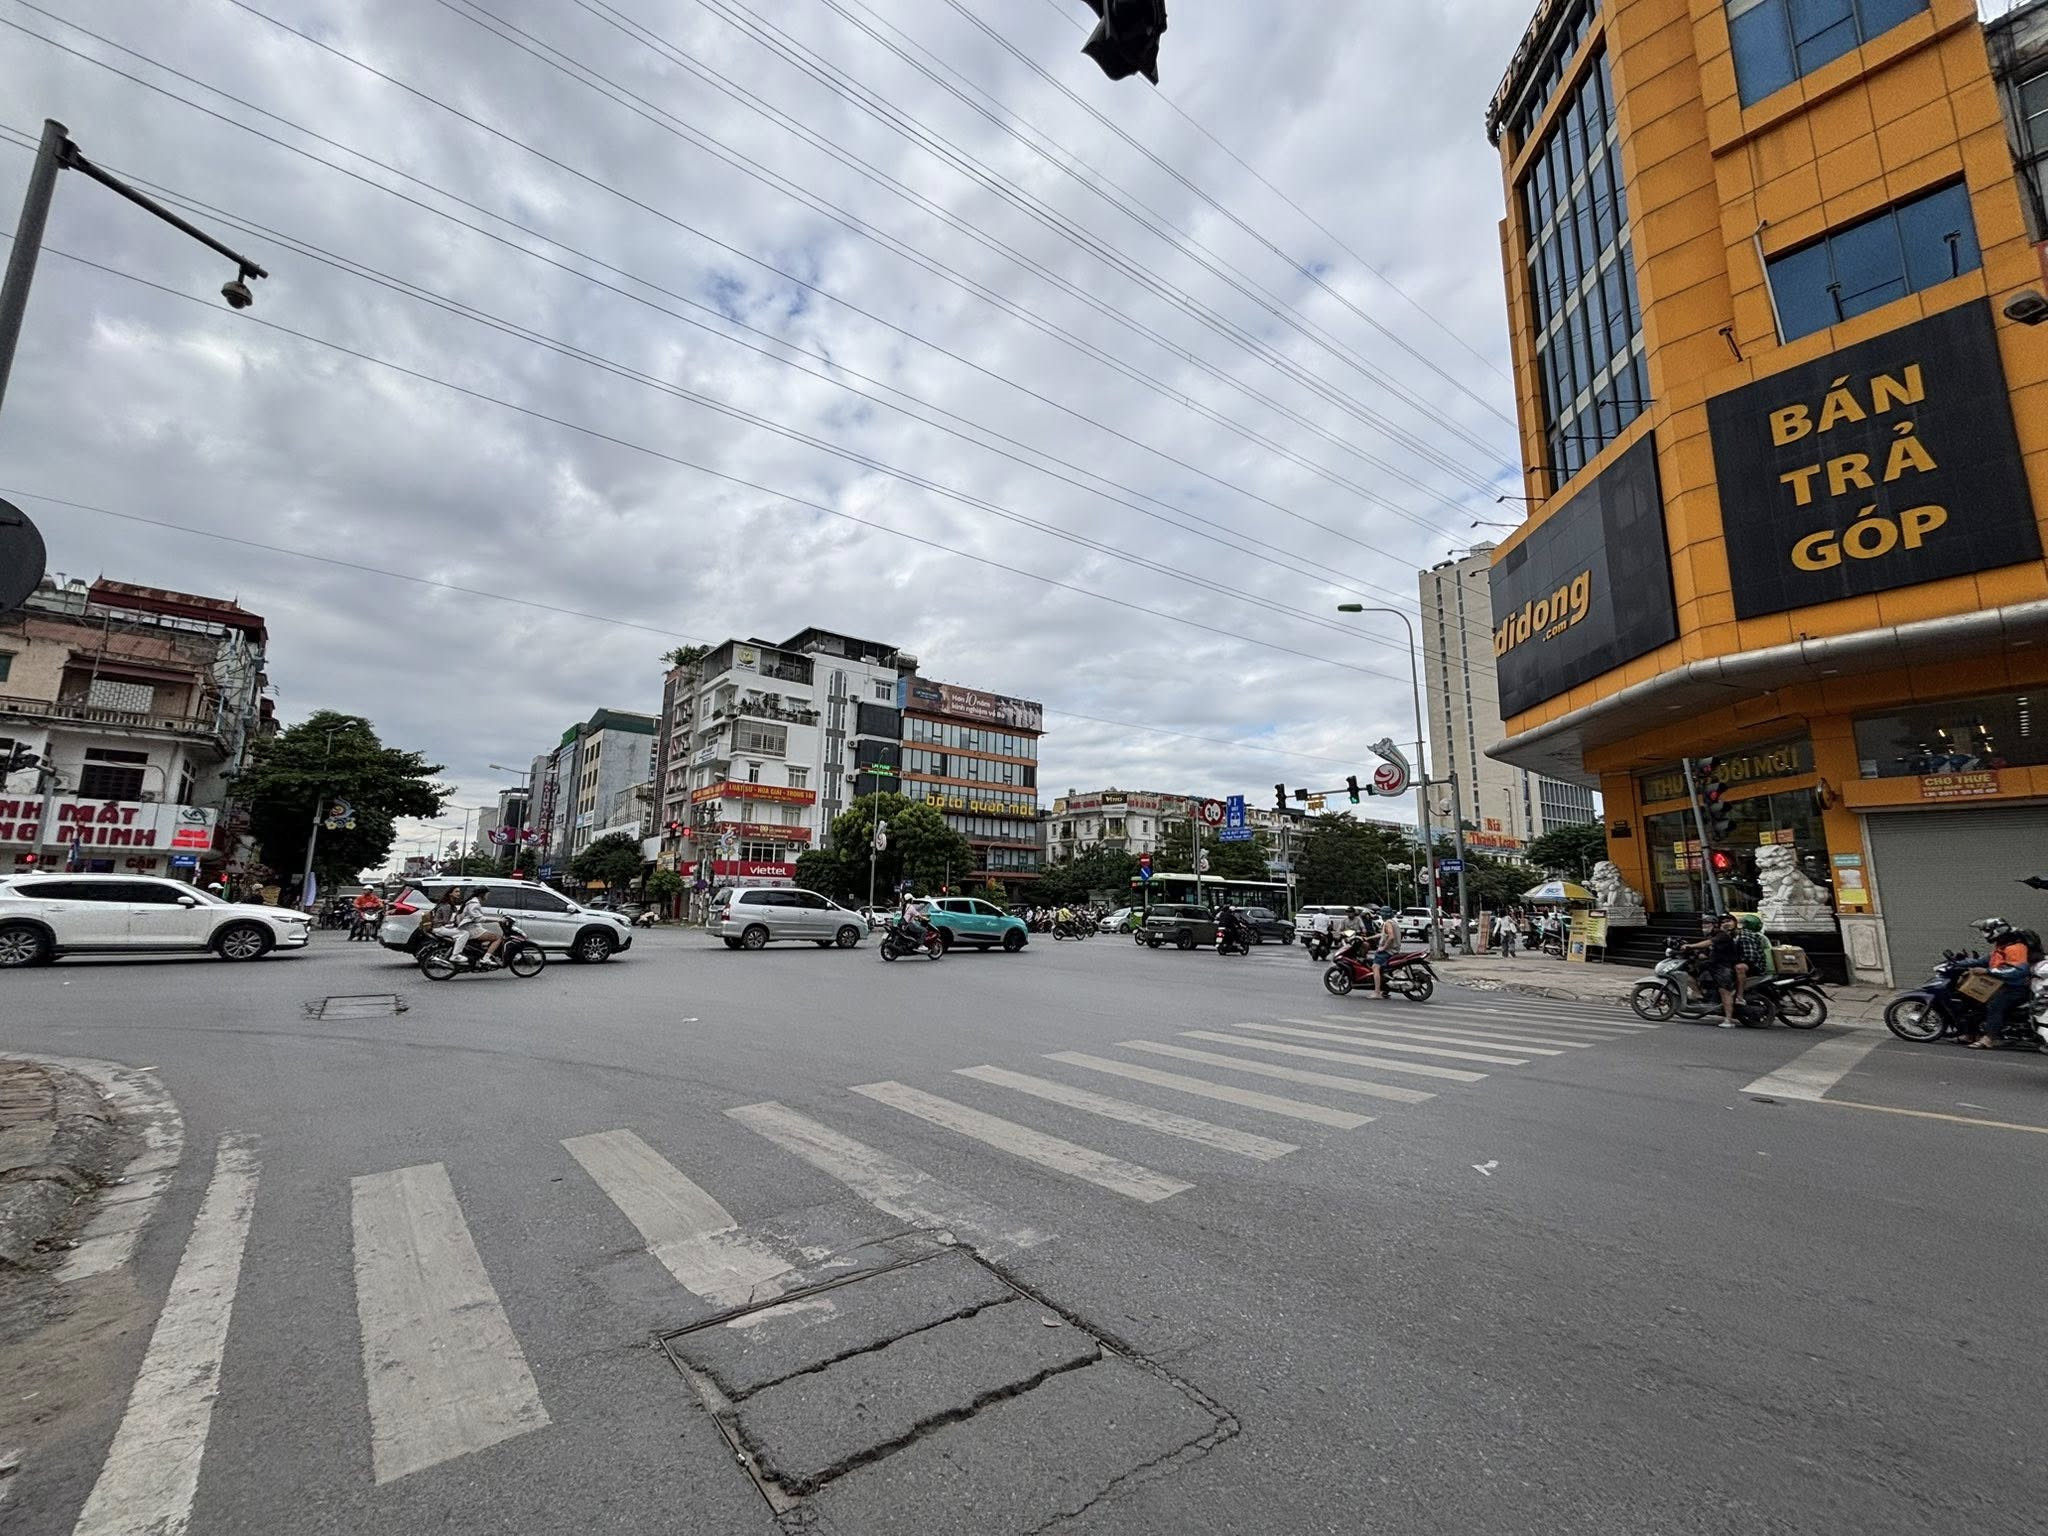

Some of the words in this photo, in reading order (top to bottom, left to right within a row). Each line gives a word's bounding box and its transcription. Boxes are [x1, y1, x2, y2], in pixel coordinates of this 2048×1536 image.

[1768, 363, 1925, 446] BÁN
[1779, 420, 1938, 506] TRẢ
[1790, 504, 1947, 571] GÓP
[1542, 619, 1568, 642] .com
[965, 691, 977, 706] 10
[1924, 777, 1952, 786] CHO
[57, 825, 156, 846] MINH
[1487, 818, 1501, 832] Bia
[749, 866, 787, 875] viettel
